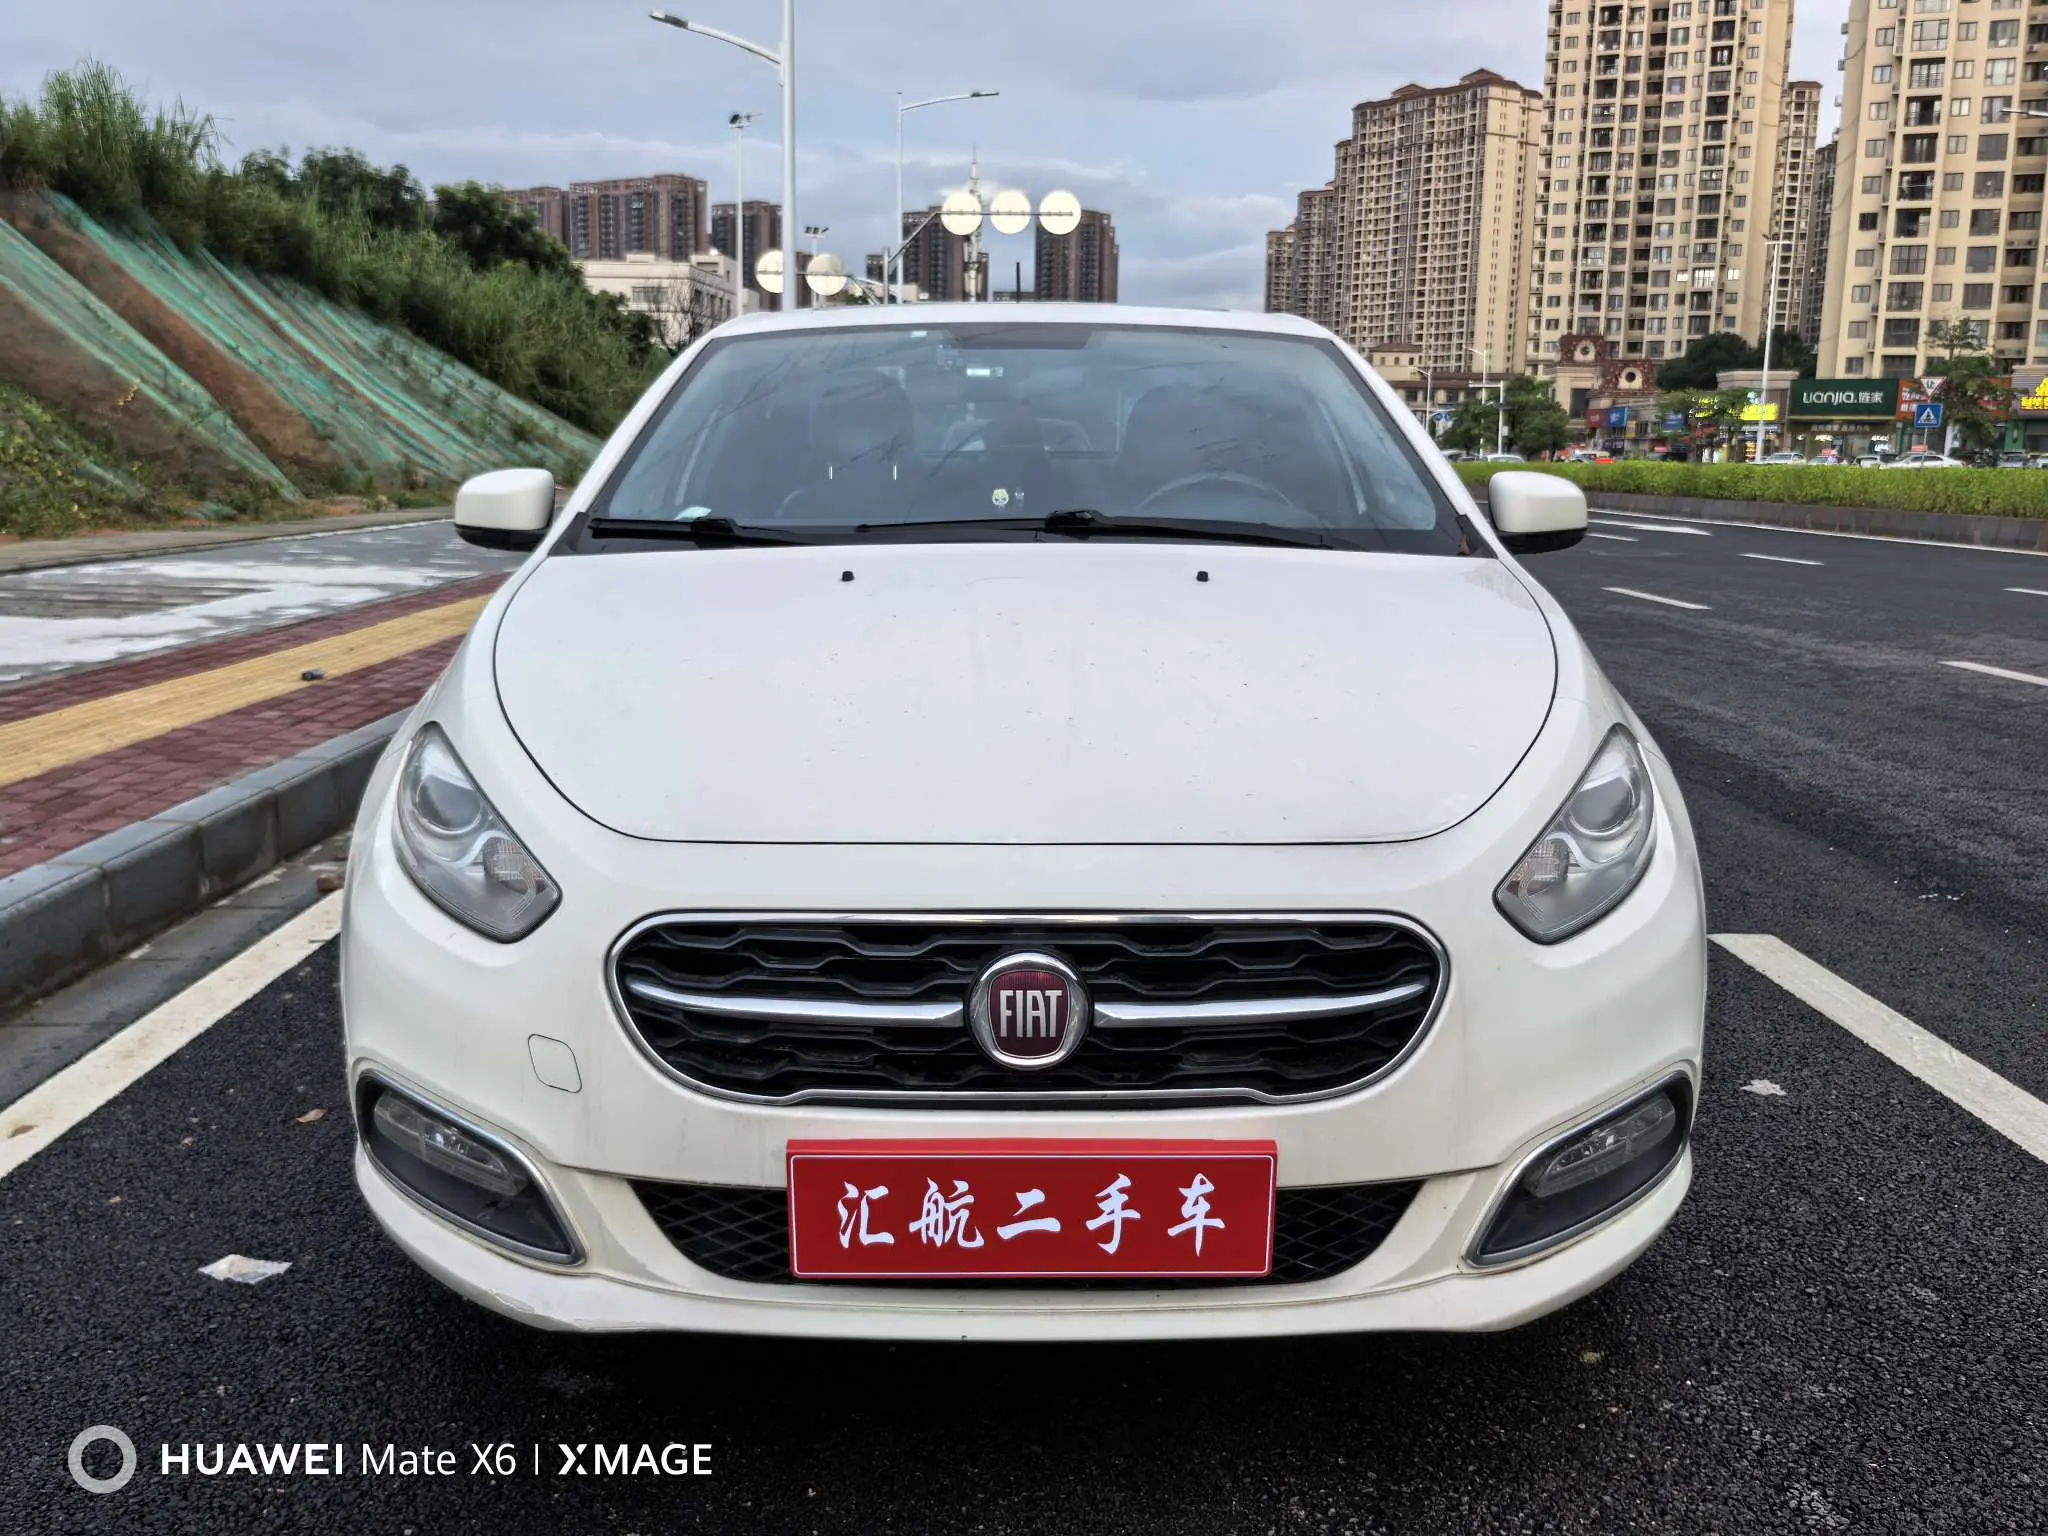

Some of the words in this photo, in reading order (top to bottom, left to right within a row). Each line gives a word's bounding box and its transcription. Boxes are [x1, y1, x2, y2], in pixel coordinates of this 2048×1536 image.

[999, 989, 1063, 1038] FIAT
[837, 1172, 1226, 1257] 汇航二手车
